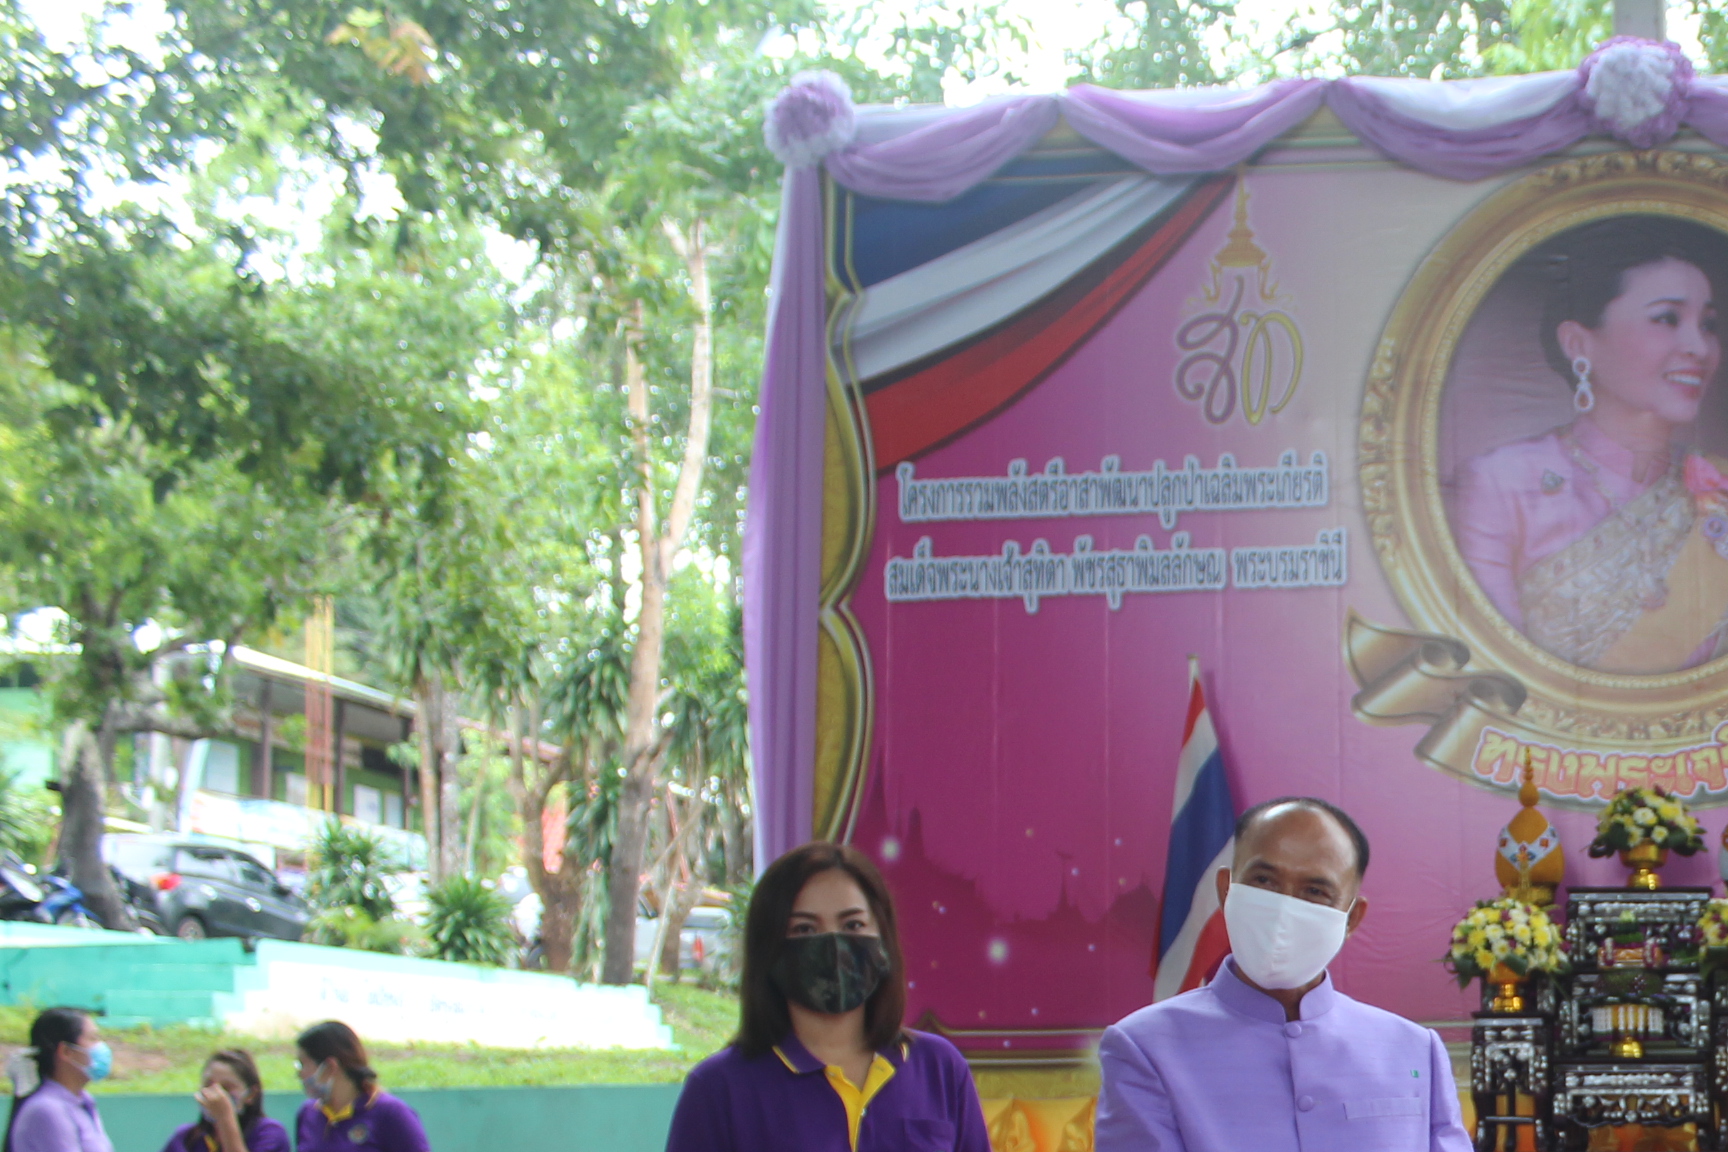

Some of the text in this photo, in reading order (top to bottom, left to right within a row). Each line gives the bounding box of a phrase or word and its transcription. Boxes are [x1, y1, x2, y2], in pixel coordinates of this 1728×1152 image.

[1233, 530, 1344, 583] พระบรมราชินี
